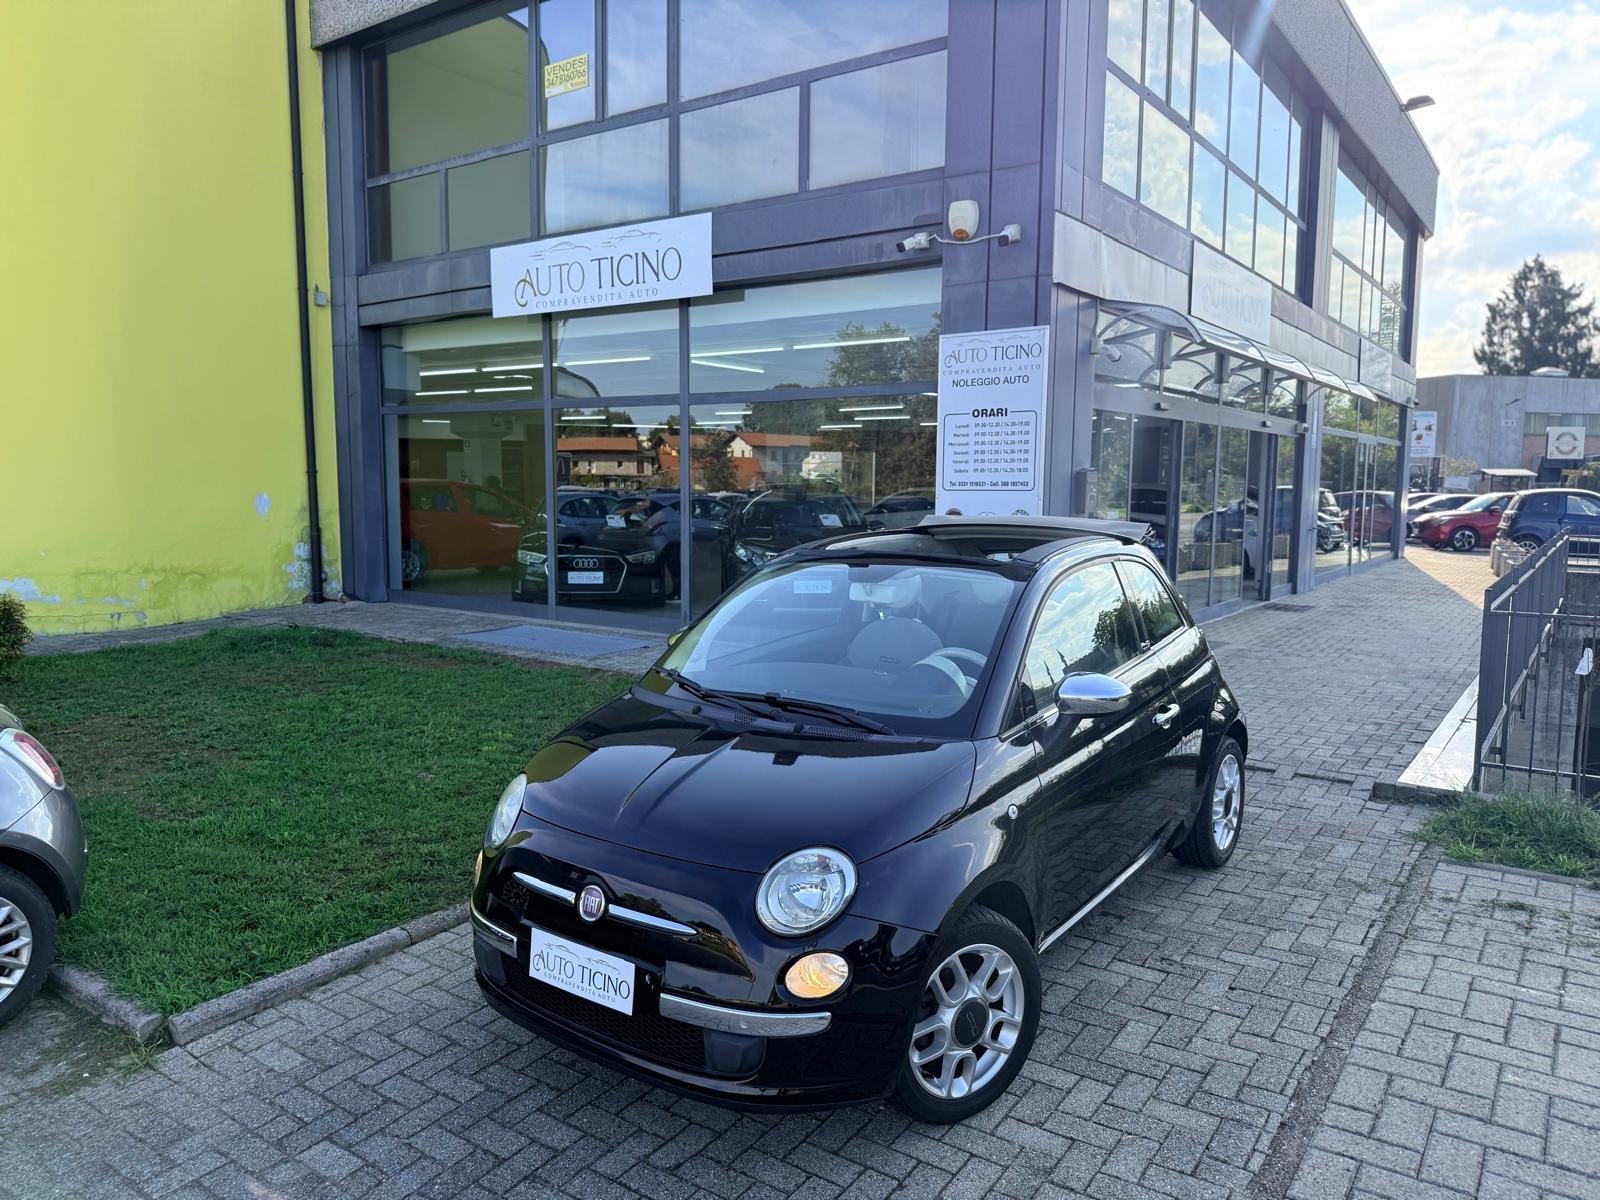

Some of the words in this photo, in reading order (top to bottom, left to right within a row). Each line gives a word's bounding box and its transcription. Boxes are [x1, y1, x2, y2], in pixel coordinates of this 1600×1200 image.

[546, 56, 587, 77] VENDESI
[515, 261, 585, 308] AUTO
[590, 247, 682, 289] TICINO
[535, 291, 622, 309] COMPRAVENDITA
[630, 287, 658, 299] AUTO
[944, 347, 987, 368] AUTO
[991, 343, 1042, 360] TICINO
[943, 367, 1013, 376] COMPRAVENDITA
[952, 377, 1001, 388] NOLEGGIO
[1003, 375, 1030, 385] AUTO
[972, 408, 1008, 418] ORARI
[585, 895, 600, 914] FIAT
[532, 950, 575, 979] AUTO
[578, 964, 631, 1000] TICINO
[543, 971, 596, 996] COMPRAVENDITA
[597, 992, 616, 1003] AUTO
